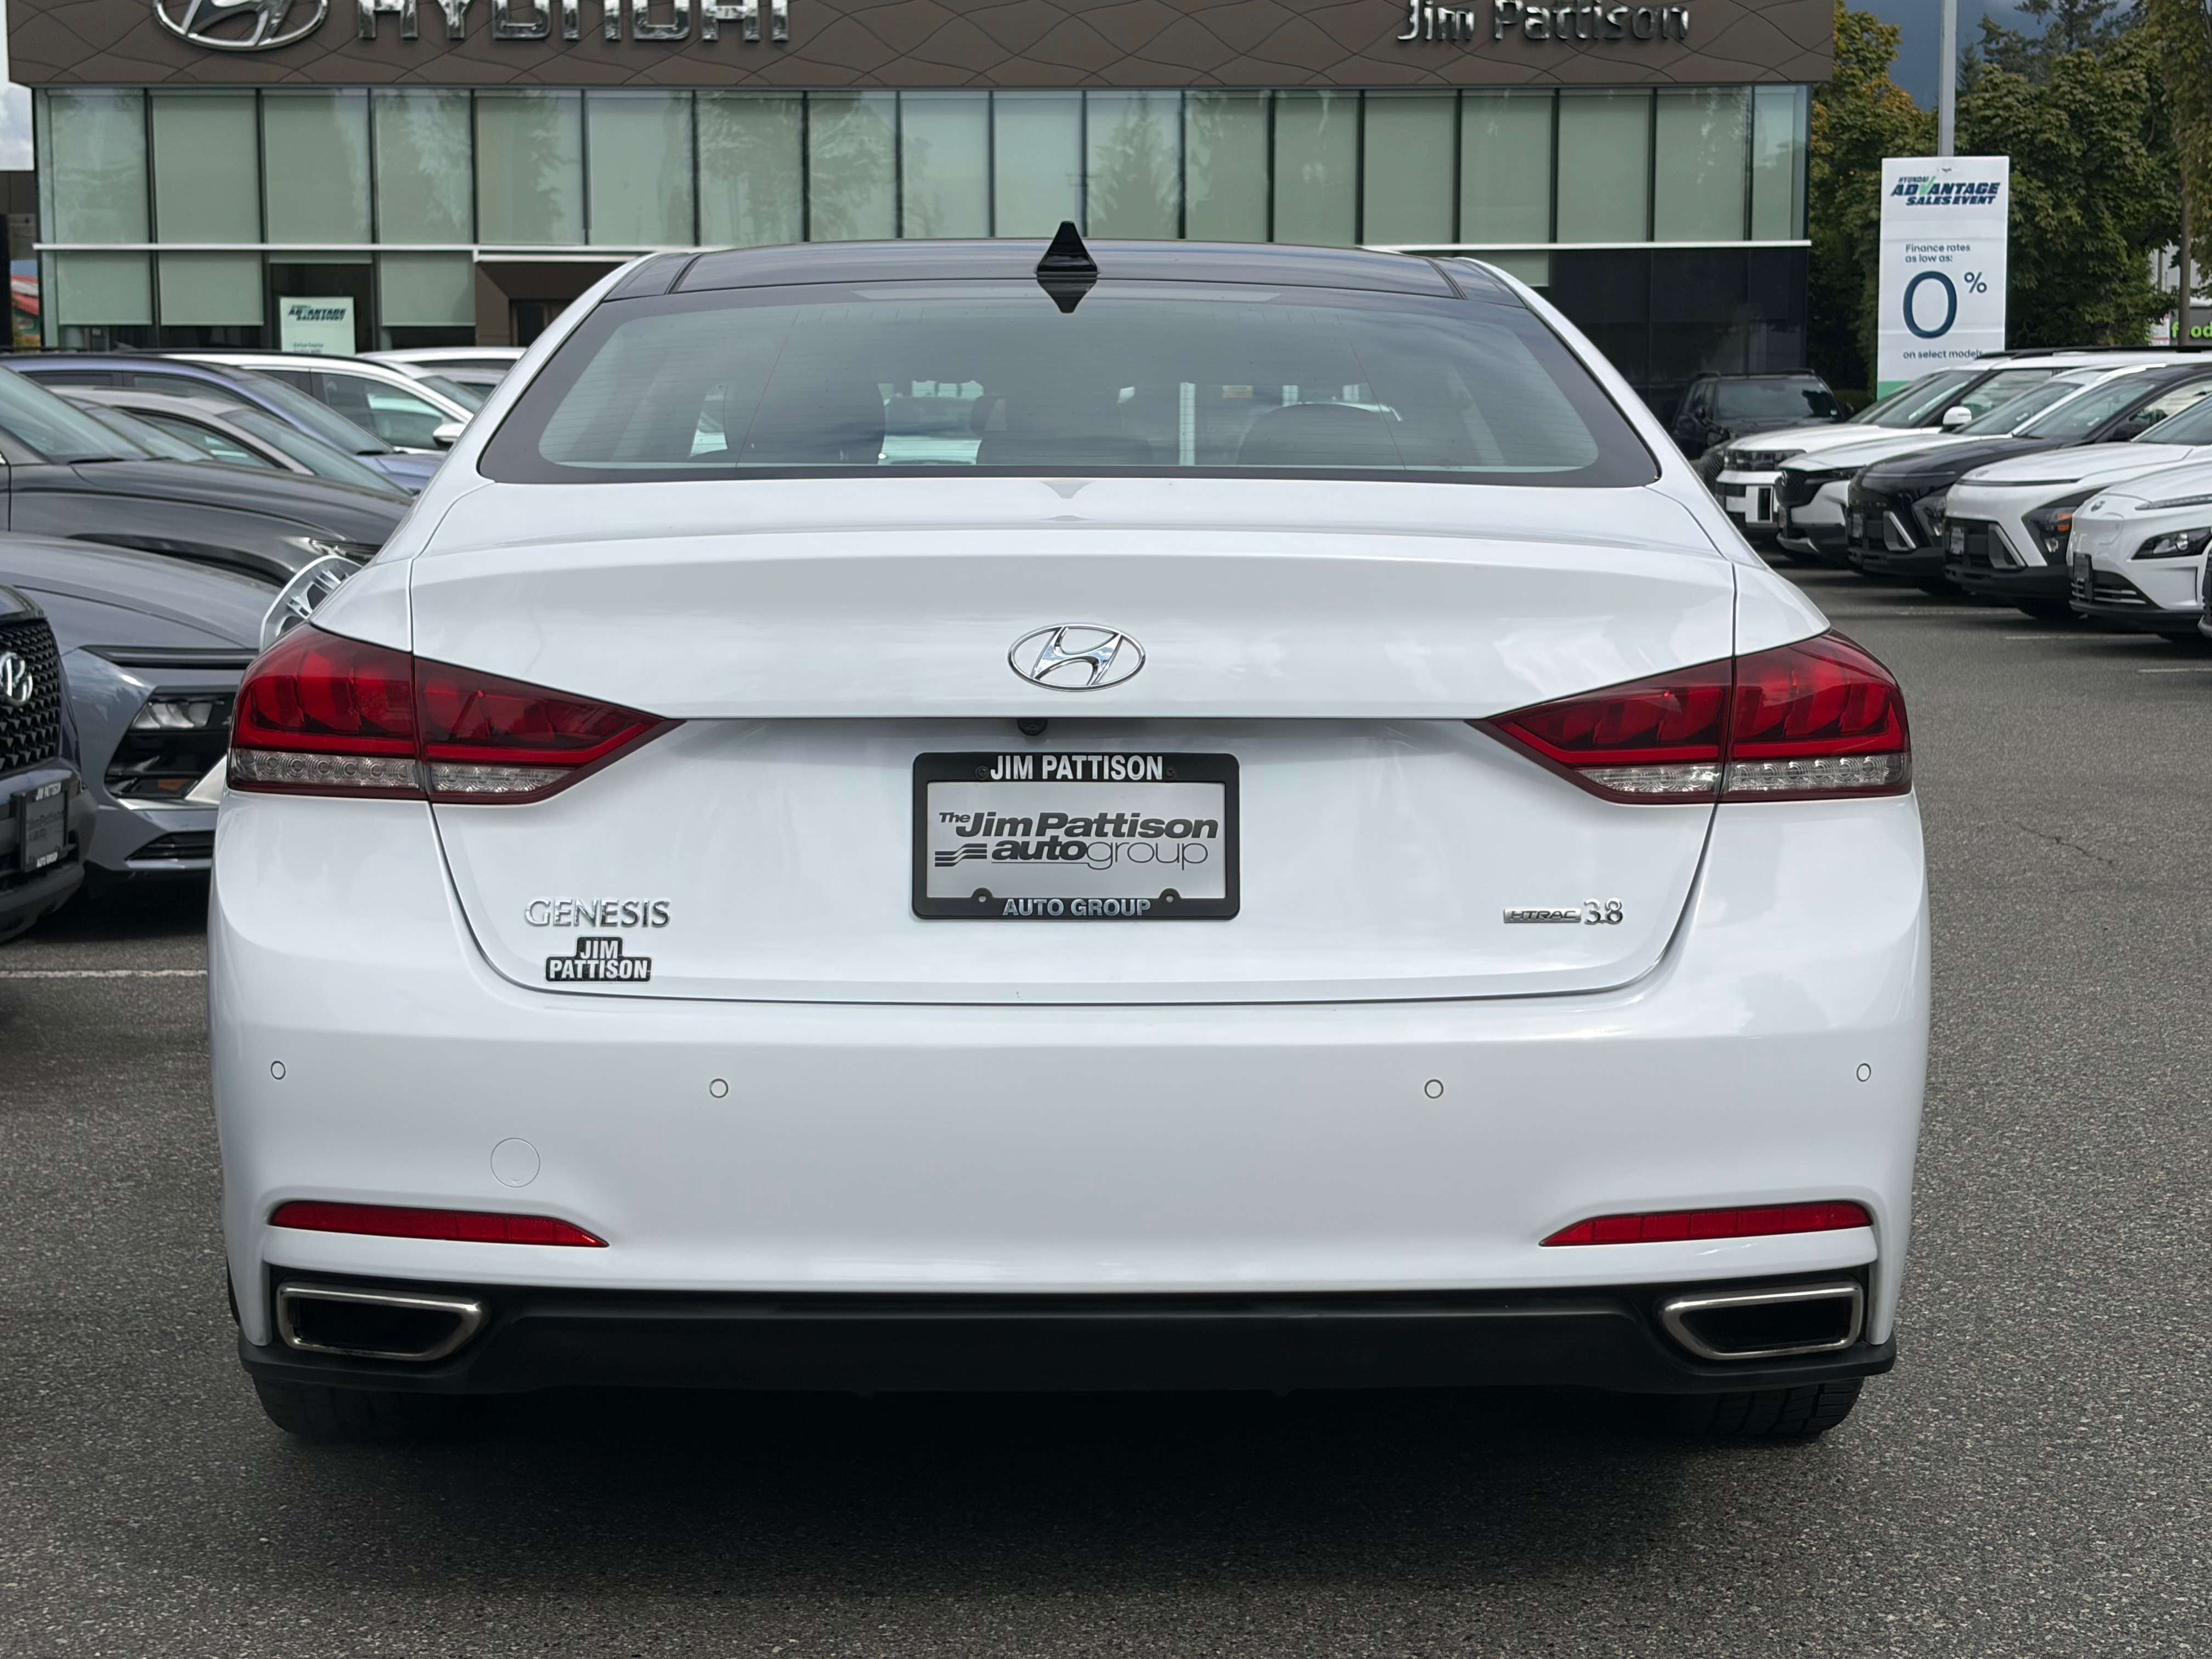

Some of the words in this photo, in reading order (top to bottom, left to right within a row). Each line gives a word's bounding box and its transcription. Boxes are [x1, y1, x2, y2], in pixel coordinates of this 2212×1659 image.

[1397, 0, 1475, 40] Jim
[1494, 0, 1689, 40] Pattison
[1891, 177, 2000, 196] ADVANTAGE
[1906, 196, 1951, 206] SALES
[1952, 195, 1996, 205] EVENT
[1905, 244, 1944, 253] Finance
[1946, 244, 1971, 252] rates
[1919, 254, 1937, 263] low
[1939, 255, 1953, 263] as:
[2171, 321, 2212, 338] fod
[1903, 351, 1916, 359] on
[1918, 349, 1947, 358] select
[990, 755, 1033, 780] JIM
[1042, 755, 1163, 780] PATTISON
[939, 812, 970, 823] The
[955, 811, 1031, 837] Jim
[1036, 812, 1219, 839] Pattison
[524, 898, 671, 927] GENESIS
[1002, 898, 1063, 916] AUTO
[1070, 898, 1151, 916] GROUP
[1510, 910, 1577, 921] HTRAC
[580, 940, 619, 959] JIM
[549, 960, 648, 979] PATTISON
